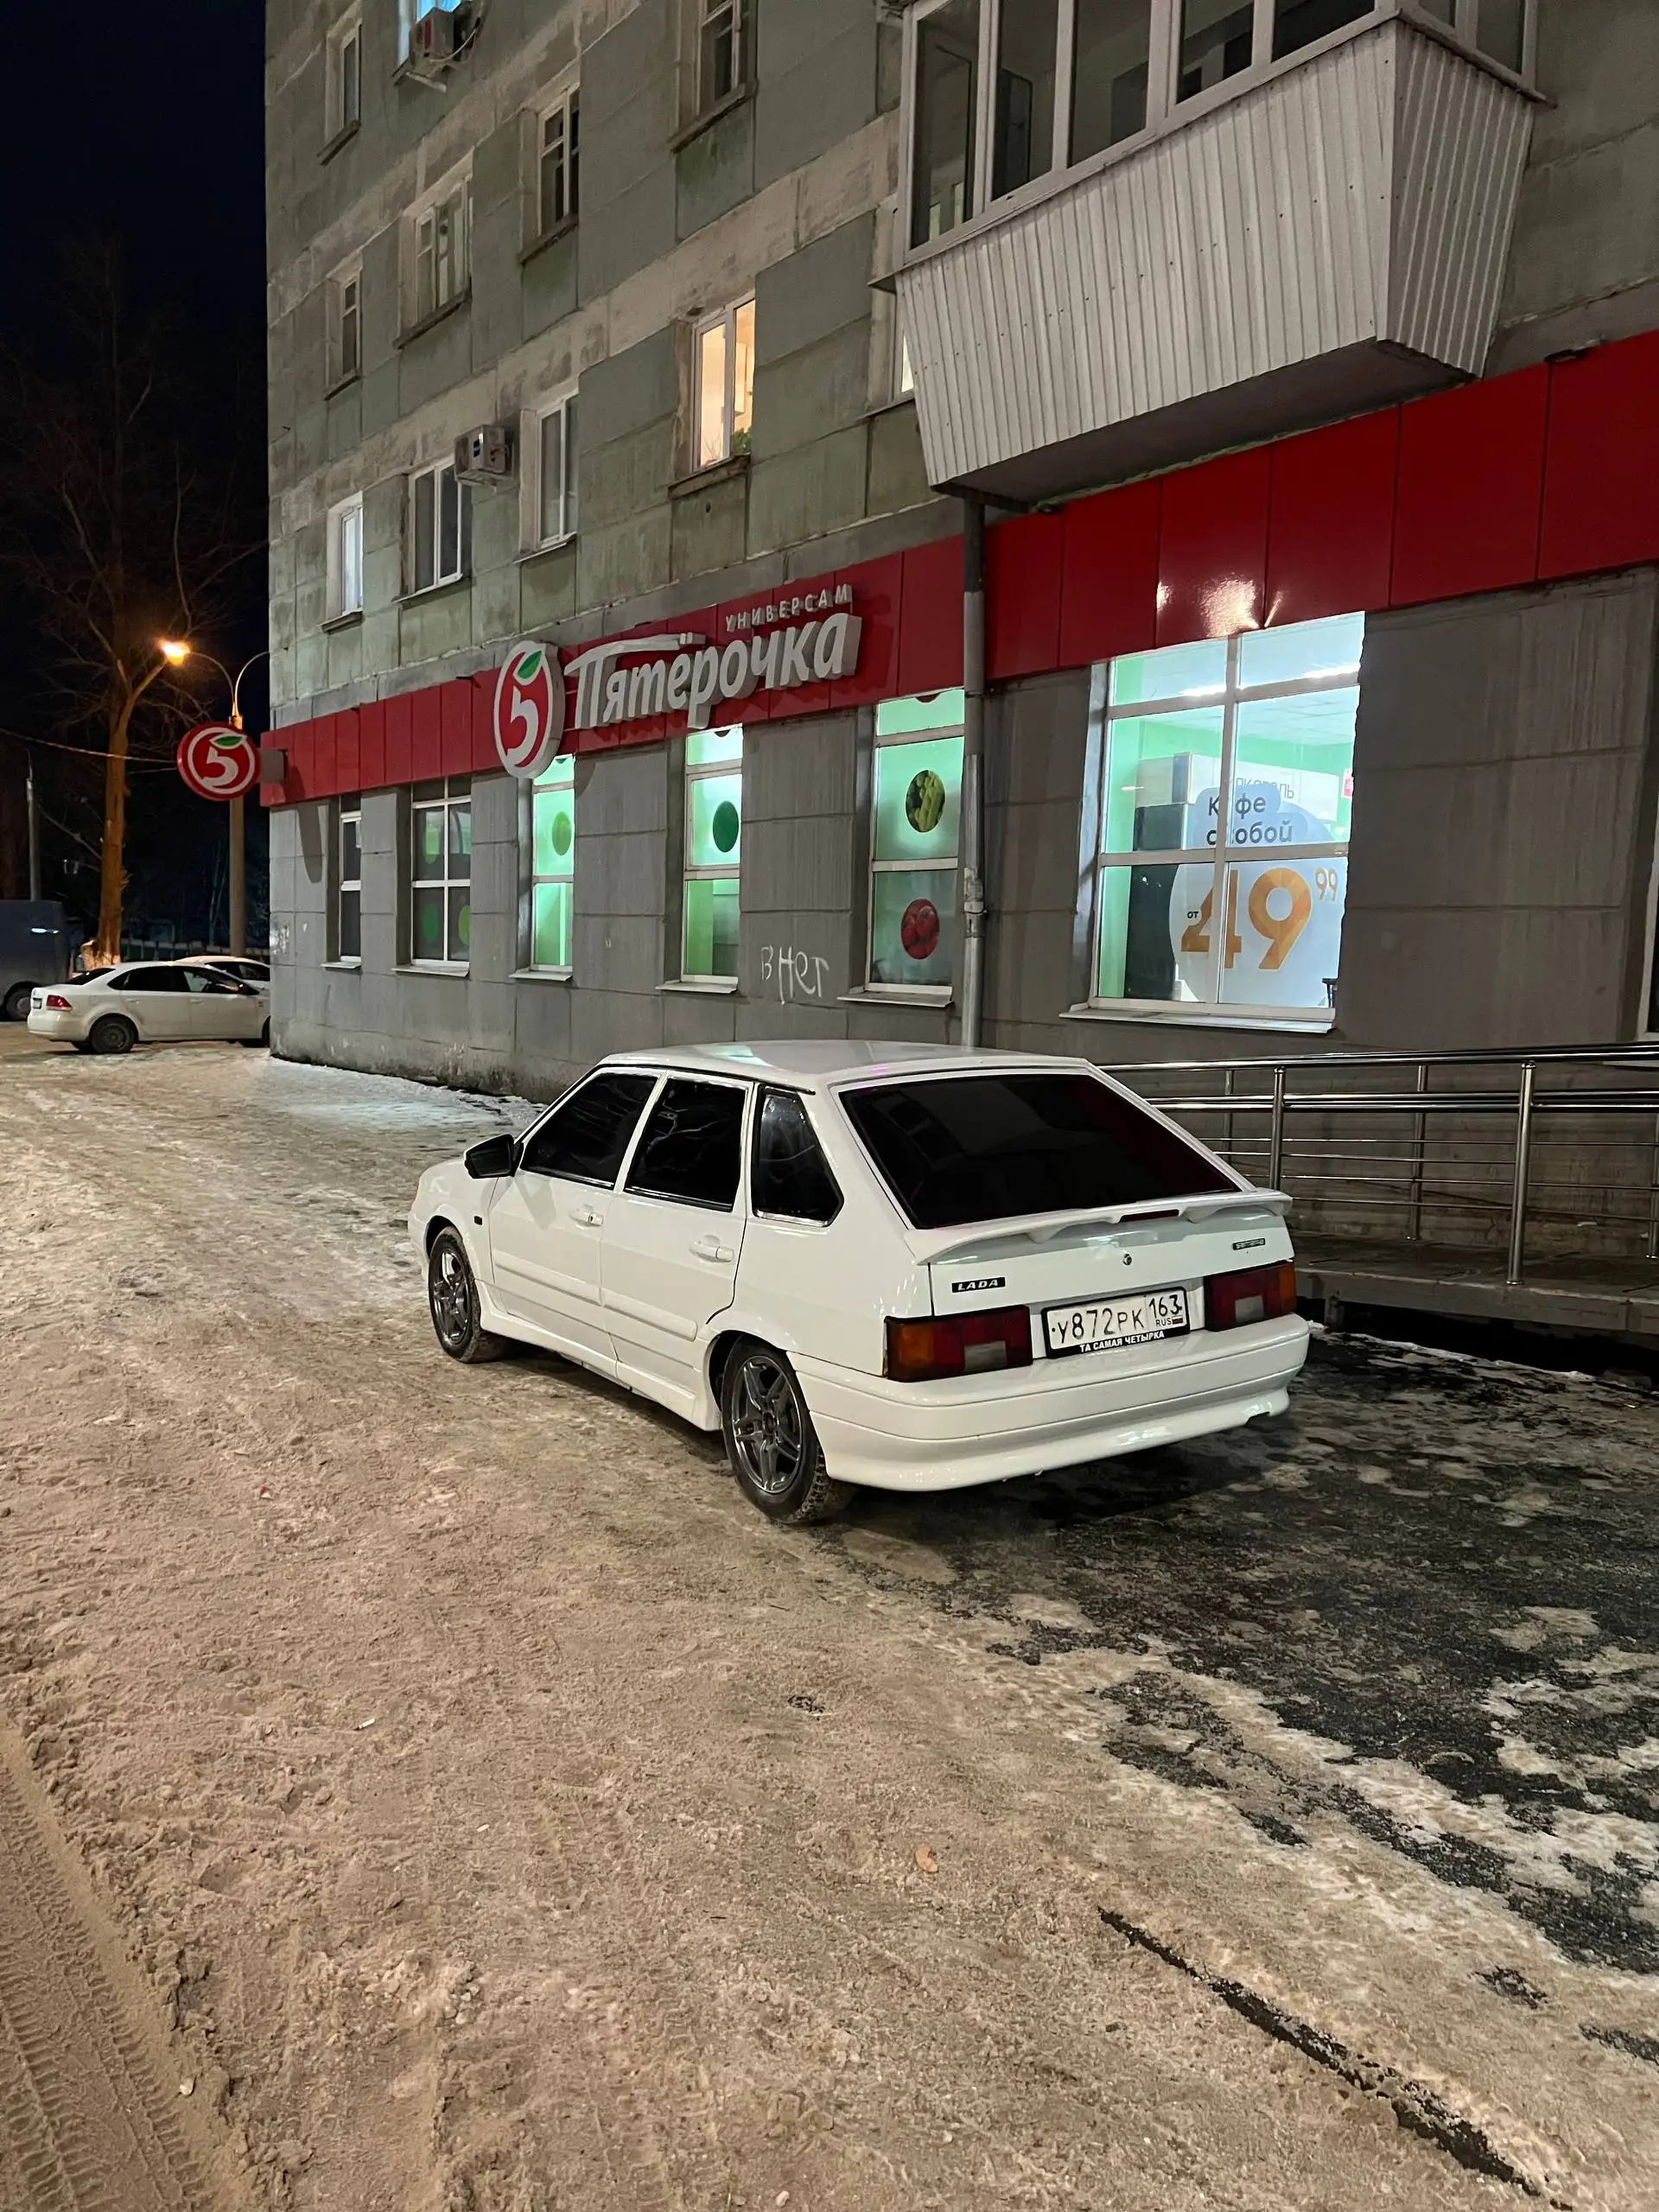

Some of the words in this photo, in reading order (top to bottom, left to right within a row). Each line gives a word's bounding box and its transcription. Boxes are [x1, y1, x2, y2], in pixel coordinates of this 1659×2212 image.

[725, 583, 851, 632] УНИВЕРСАМ
[564, 613, 860, 729] Пятёрочка
[1208, 793, 1267, 819] Кфе
[1180, 867, 1312, 969] 49
[1314, 867, 1338, 902] 99
[957, 1279, 999, 1291] LADA
[1155, 1318, 1173, 1327] RUS
[1080, 1344, 1091, 1354] ТА
[1093, 1338, 1123, 1351] САМАЯ
[1124, 1330, 1165, 1345] ЧЕТЫРКА
